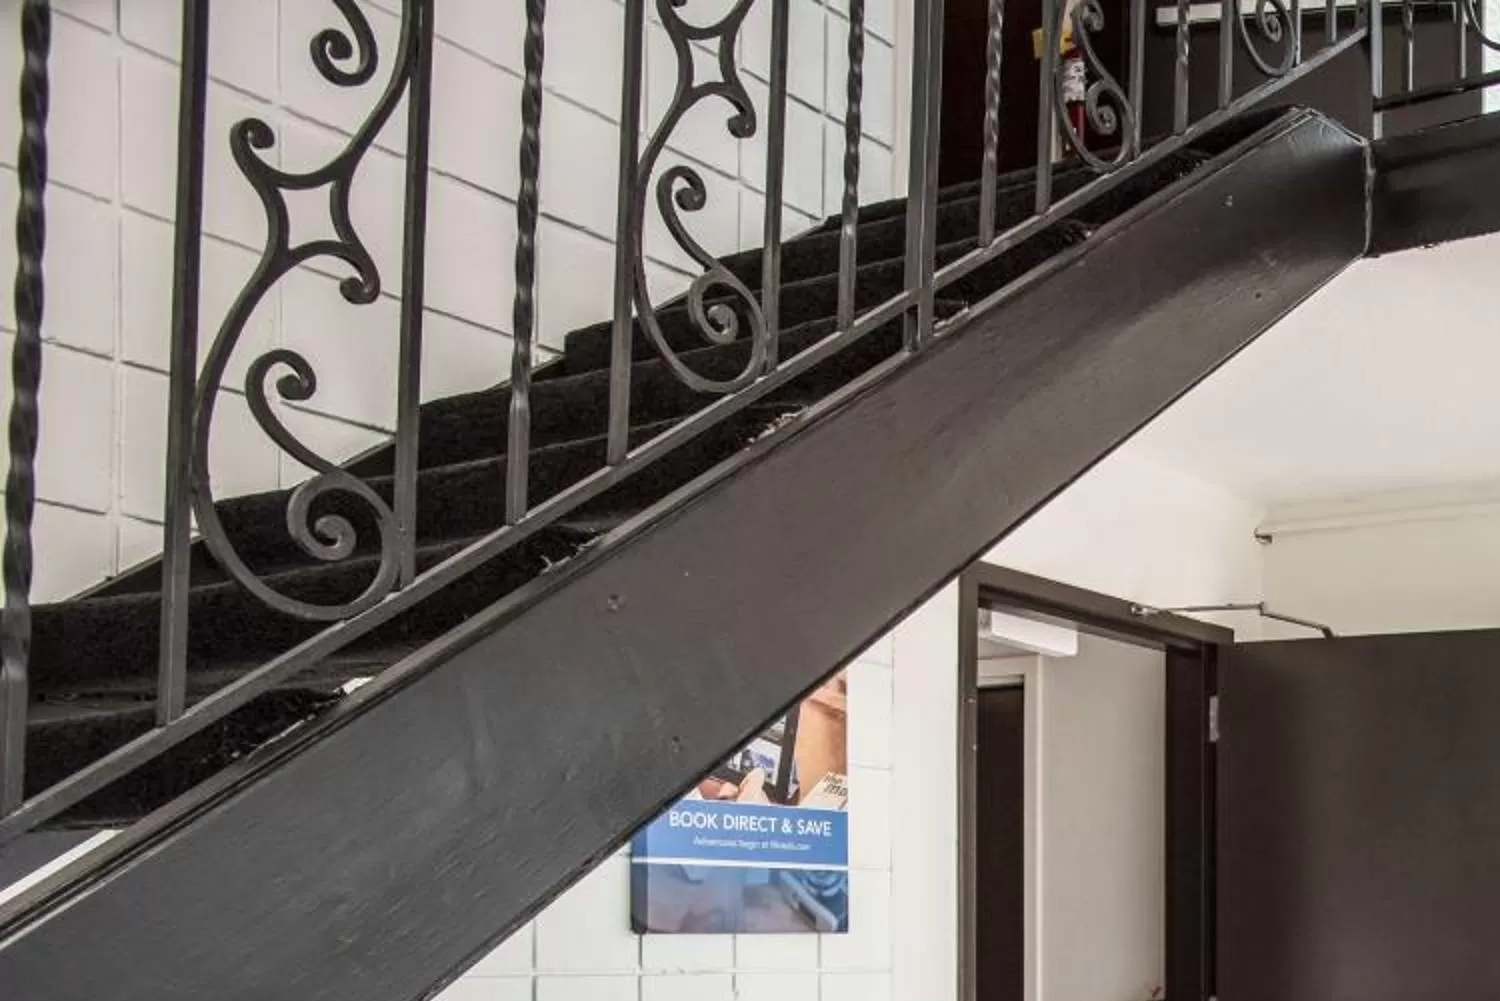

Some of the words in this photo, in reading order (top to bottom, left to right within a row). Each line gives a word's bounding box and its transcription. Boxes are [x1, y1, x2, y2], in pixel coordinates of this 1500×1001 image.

[669, 811, 718, 829] BOOK
[723, 814, 777, 833] DIRECT
[781, 819, 793, 833] &
[797, 819, 832, 837] SAVE
